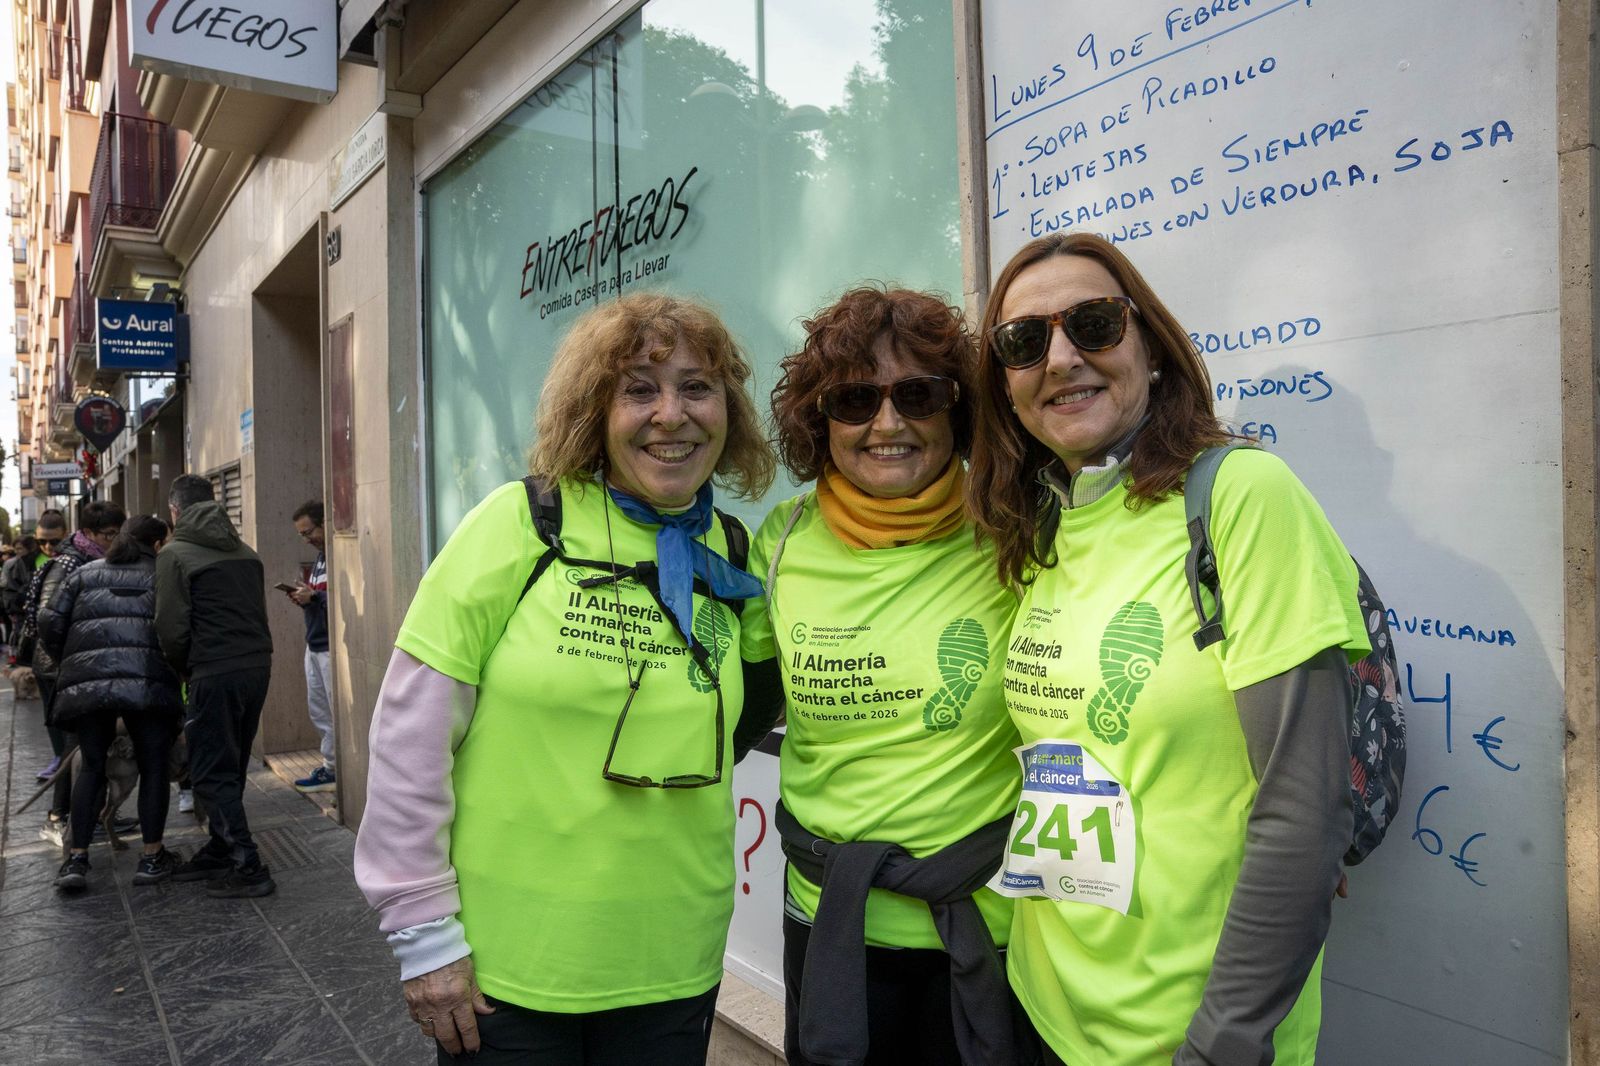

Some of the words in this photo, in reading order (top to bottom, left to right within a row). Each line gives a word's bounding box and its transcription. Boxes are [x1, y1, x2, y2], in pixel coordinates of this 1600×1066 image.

[993, 67, 1066, 122] LUNES
[1077, 33, 1099, 71] 9
[1109, 32, 1152, 68] DE
[1025, 121, 1088, 164] SOPA
[1101, 103, 1131, 134] DE
[1143, 56, 1277, 115] PICADILLO
[1030, 188, 1155, 237] ENSALADA
[1173, 167, 1204, 195] DE
[1222, 110, 1370, 175] SIEMPRE
[1032, 144, 1147, 198] LENTEJAS
[1163, 203, 1209, 231] CON
[1394, 119, 1514, 174] SOJA
[520, 166, 698, 299] ENTREFUEGOS
[540, 293, 572, 320] Comida
[574, 279, 607, 306] Casera
[609, 270, 632, 294] para
[635, 253, 670, 280] Llevar
[126, 314, 173, 333] Aural
[102, 338, 133, 346] Centros
[136, 339, 173, 348] Auditivos
[112, 347, 165, 356] Profesionales
[586, 594, 663, 624] Almería
[564, 611, 586, 624] en
[590, 613, 652, 636] marcha
[1385, 608, 1517, 647] AVELLANA
[559, 626, 616, 646] contra
[619, 636, 635, 650] el
[638, 639, 688, 656] cáncer
[557, 645, 564, 654] 8
[567, 646, 581, 656] de
[585, 647, 624, 665] febrero
[627, 657, 638, 668] de
[804, 652, 887, 673] Almería
[1006, 657, 1014, 670] en
[1014, 659, 1047, 678] marcha
[791, 673, 805, 687] en
[808, 674, 873, 689] marcha
[1031, 681, 1041, 698] el
[1042, 684, 1085, 701] cáncer
[791, 689, 836, 706] contra
[840, 691, 858, 706] el
[861, 687, 924, 705] cáncer
[1013, 700, 1037, 716] febrero
[1039, 706, 1048, 718] de
[1050, 708, 1069, 720] 2026
[801, 708, 810, 719] de
[812, 711, 850, 722] febrero
[853, 710, 867, 720] de
[871, 708, 898, 719] 2026
[1406, 662, 1451, 754] 4
[1472, 716, 1520, 772] €
[1029, 769, 1038, 782] el
[1040, 769, 1081, 785] cáncer
[1010, 800, 1116, 864] 241
[1412, 785, 1449, 856] 6
[1449, 832, 1488, 887] €
